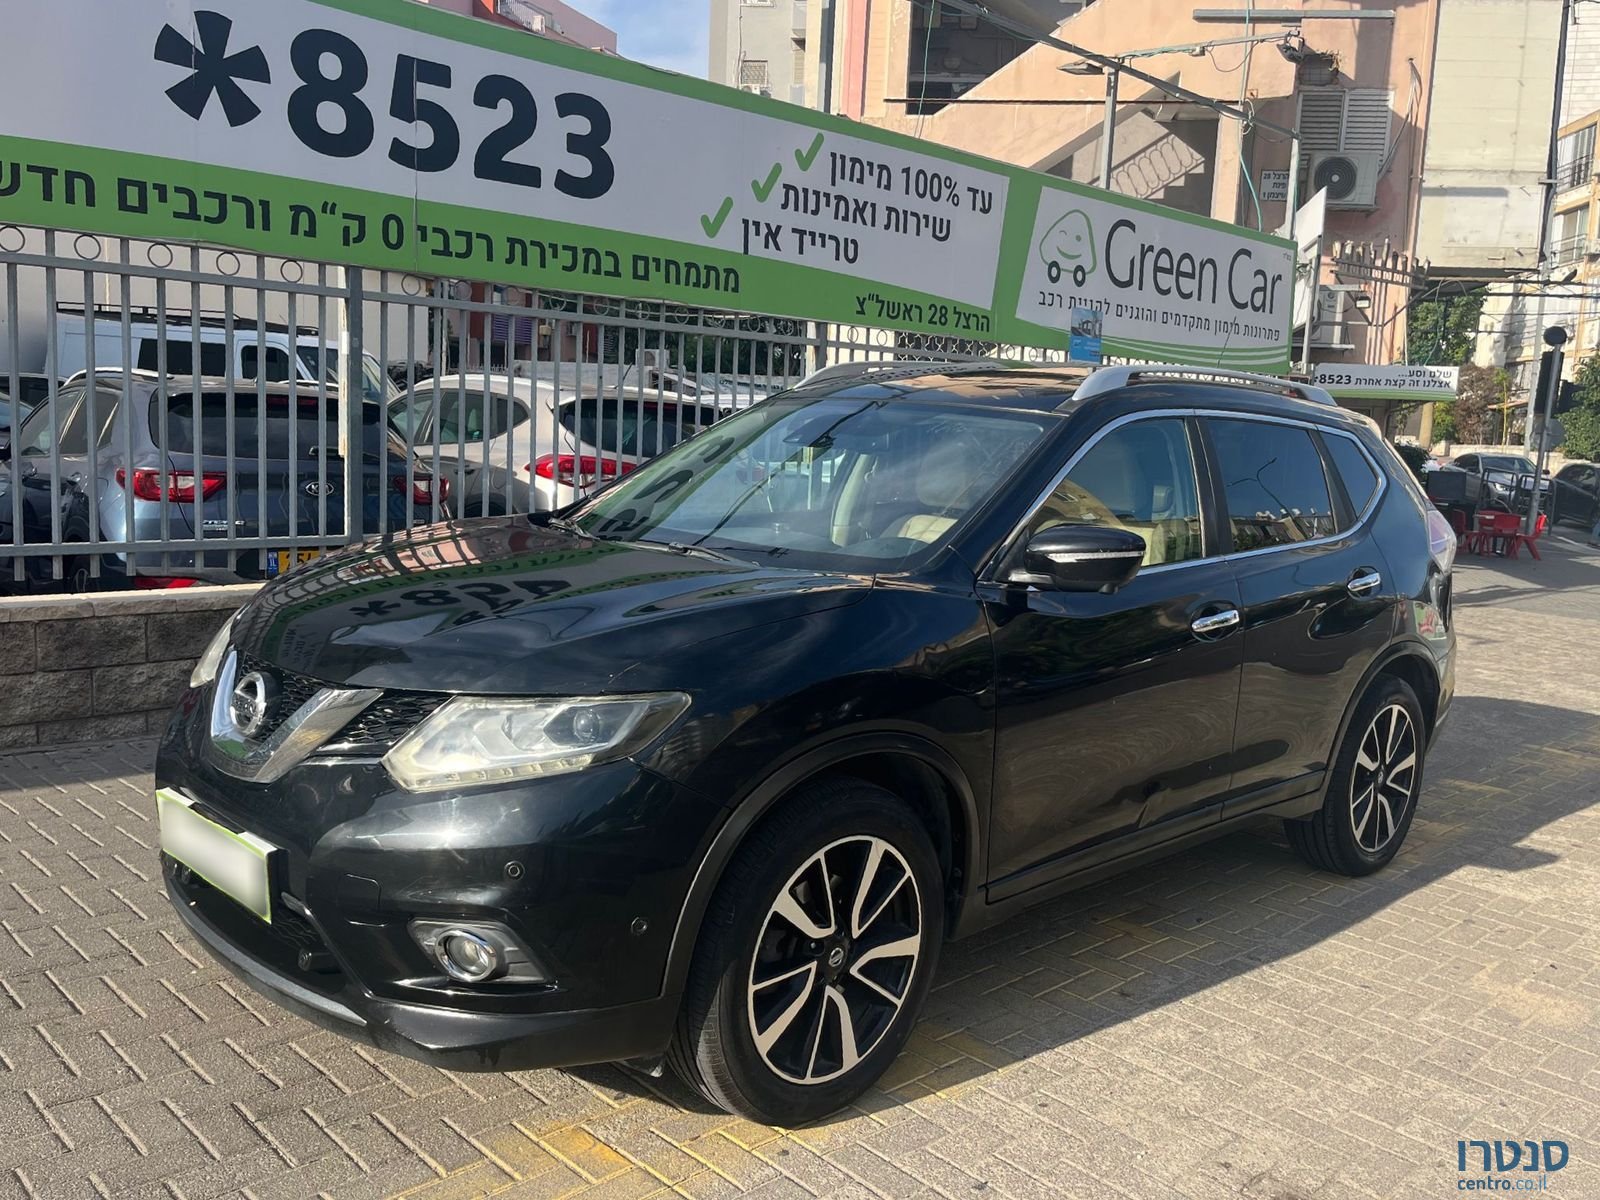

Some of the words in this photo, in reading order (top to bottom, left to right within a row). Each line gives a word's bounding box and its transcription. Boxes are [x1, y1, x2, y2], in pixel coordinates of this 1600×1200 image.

[830, 151, 892, 191] מימון
[901, 166, 960, 207] 100%
[967, 186, 993, 214] עד
[117, 177, 271, 232] ורכבים
[781, 183, 877, 227] ואמינות
[742, 218, 782, 255] אין
[883, 205, 951, 242] שירות
[416, 224, 494, 262] רכבי
[505, 236, 622, 278] במכירת
[791, 227, 859, 264] טרייד
[632, 254, 740, 293] מתמחים
[1105, 219, 1217, 304] Green
[1228, 248, 1282, 314] Car
[1038, 290, 1063, 308] רכב
[1115, 303, 1157, 322] והוגנים
[927, 303, 948, 326] 28
[953, 305, 990, 333] הרצל
[1161, 311, 1210, 332] מתקדמים
[1214, 319, 1240, 336] מימון
[1243, 324, 1280, 341] פתרונות
[1354, 377, 1382, 386] אחרת
[1384, 378, 1406, 389] קצת
[1408, 379, 1421, 388] זה
[1423, 379, 1451, 388] אצלנו
